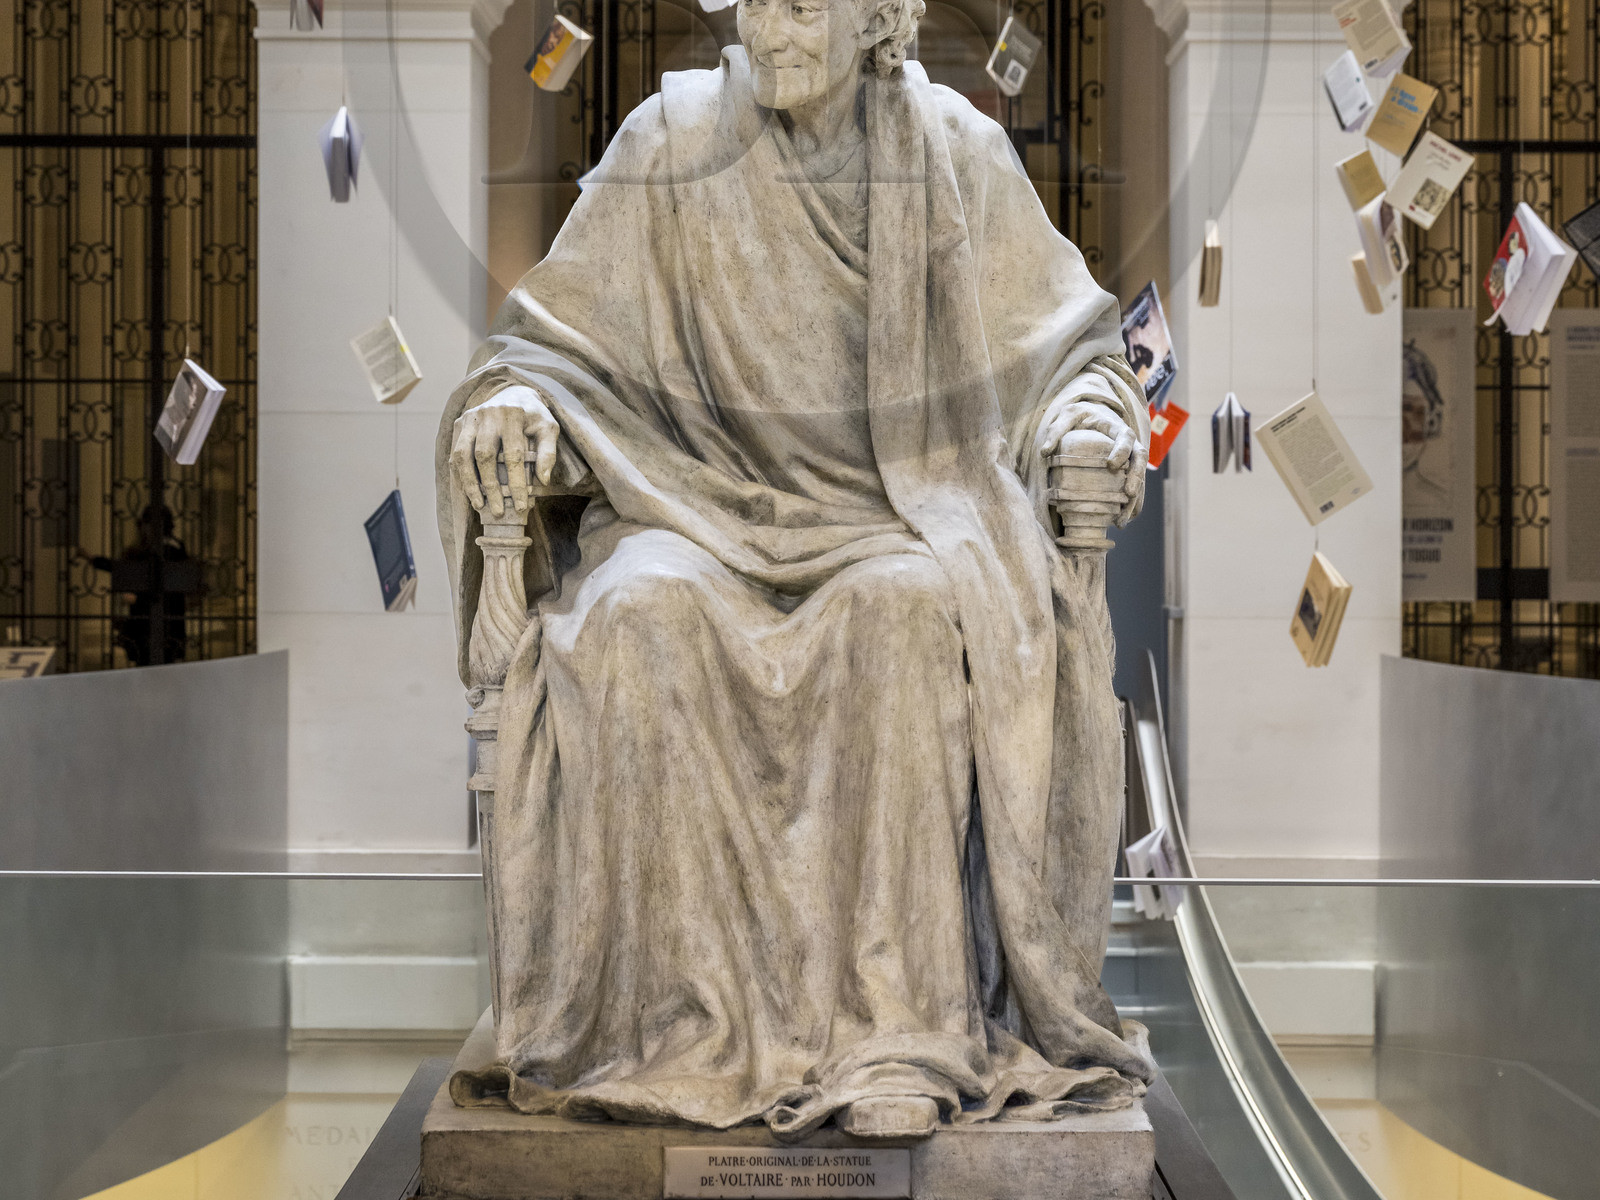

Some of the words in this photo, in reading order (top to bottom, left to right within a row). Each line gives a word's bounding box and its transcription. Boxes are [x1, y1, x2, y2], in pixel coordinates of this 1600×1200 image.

[708, 1156, 746, 1167] PLATRE
[749, 1156, 798, 1167] ORIGINAL
[817, 1156, 830, 1167] LA
[833, 1156, 872, 1167] STATUE
[700, 1176, 714, 1187] DE
[719, 1173, 783, 1187] VOLTAIRE
[791, 1176, 811, 1187] PAR
[817, 1173, 875, 1187] HOUDON
